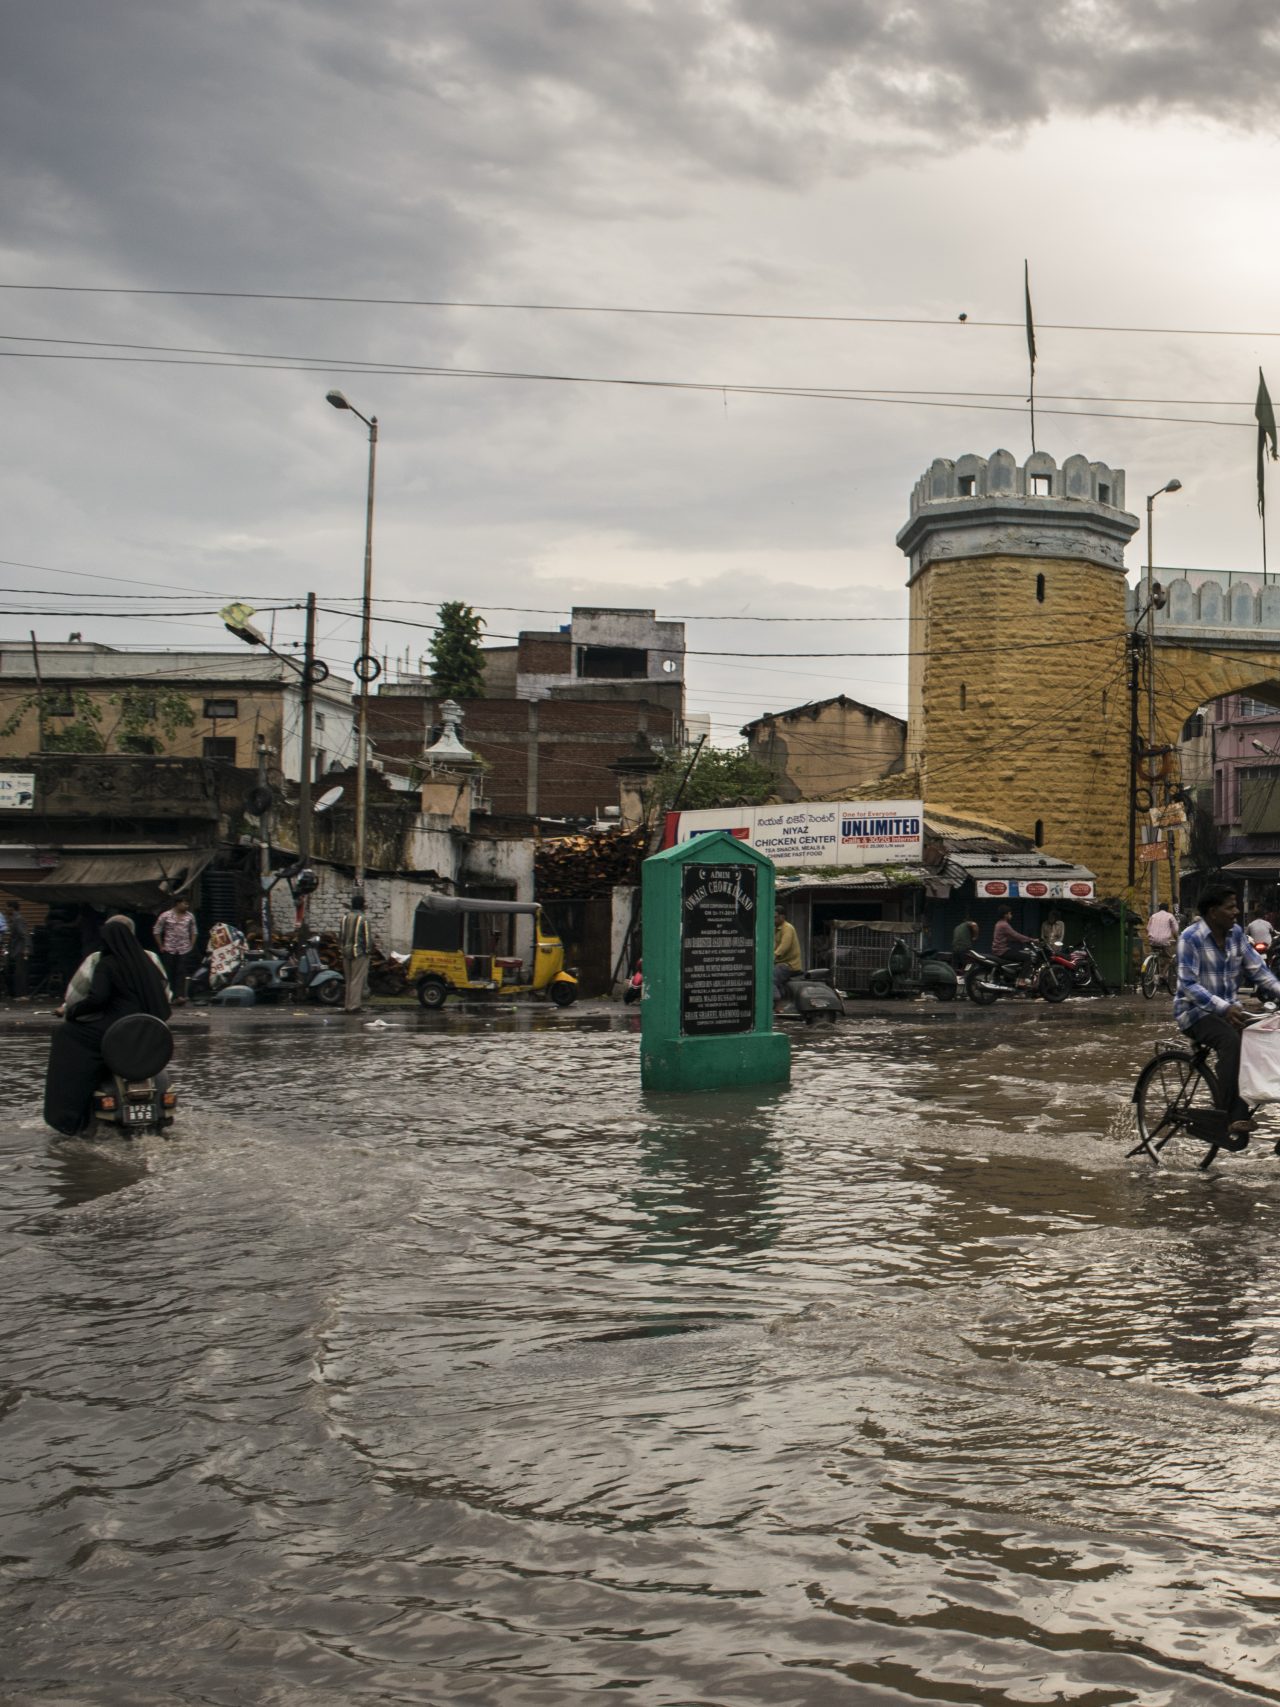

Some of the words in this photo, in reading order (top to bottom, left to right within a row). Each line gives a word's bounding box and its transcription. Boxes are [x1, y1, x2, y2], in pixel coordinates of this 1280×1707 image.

[782, 826, 809, 835] NIYAZ
[842, 819, 919, 836] UNLIMITED
[755, 838, 797, 847] CHICKEN
[799, 835, 836, 844] CENTER
